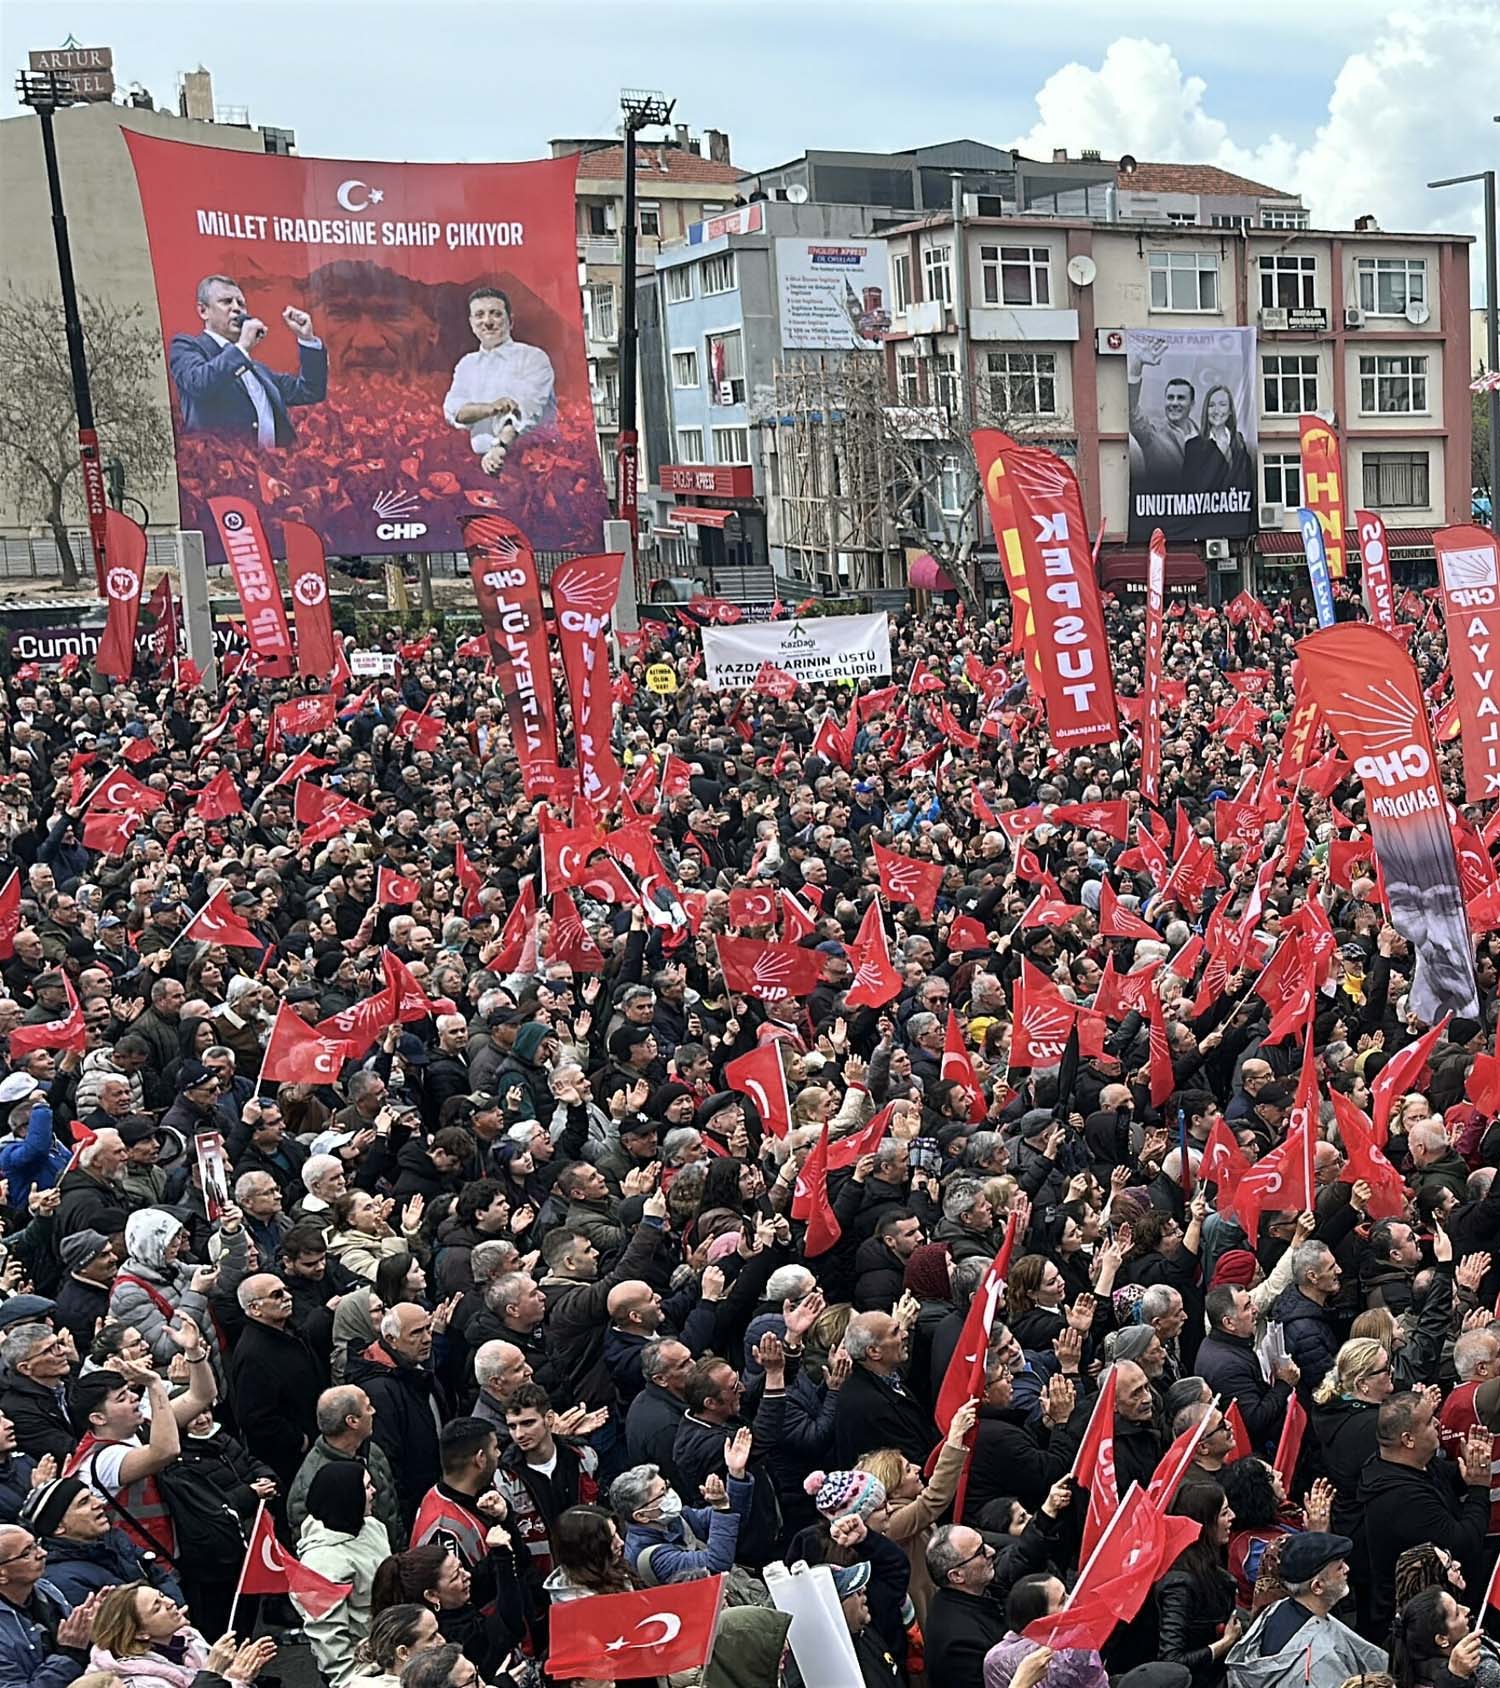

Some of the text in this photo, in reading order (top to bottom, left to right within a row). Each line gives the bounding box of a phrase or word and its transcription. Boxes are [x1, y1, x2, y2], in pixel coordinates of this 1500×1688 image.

[37, 49, 103, 69] ARTUR
[196, 209, 525, 251] MİLLET İRADESİNE SAHİP ÇIKIYOR
[1135, 487, 1252, 518] UNUTMAYACAĞIZ
[376, 522, 428, 541] CHP
[780, 639, 816, 650] KazDağı
[838, 650, 876, 664] ÜSTÜ
[751, 984, 790, 1001] CHP
